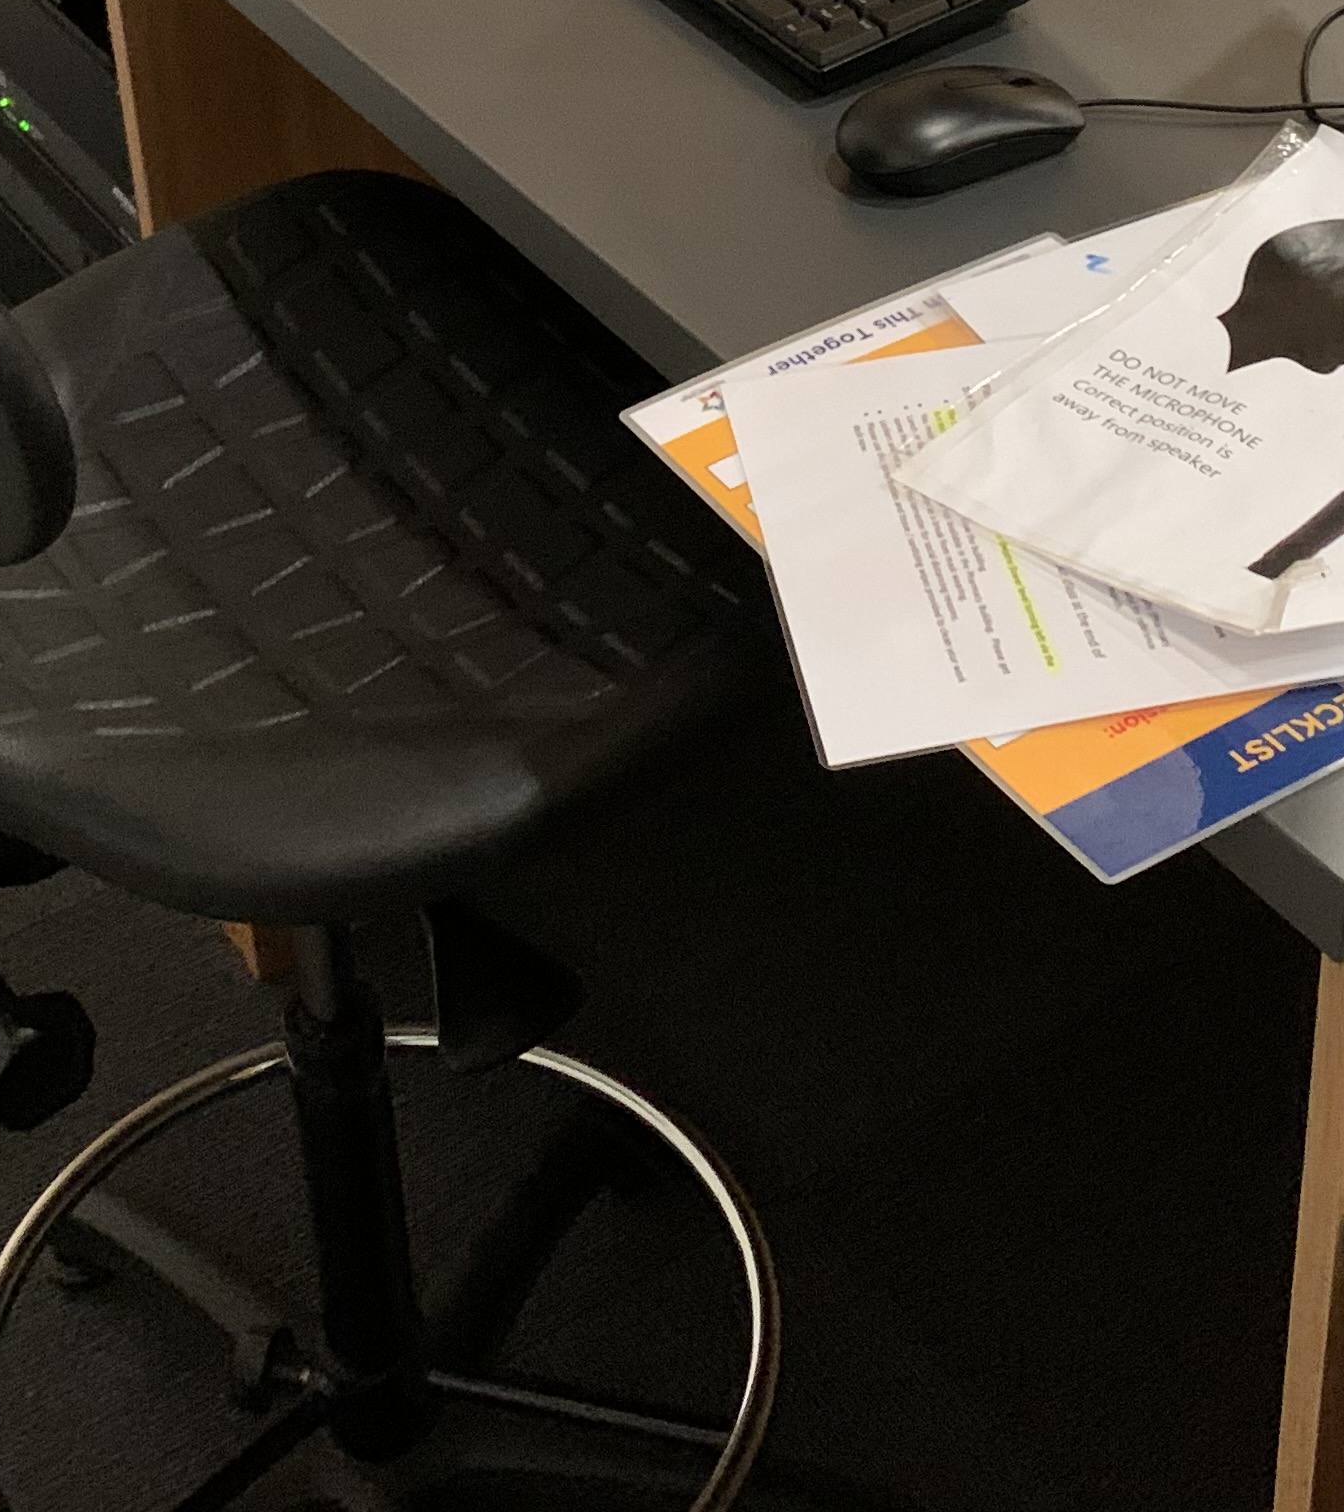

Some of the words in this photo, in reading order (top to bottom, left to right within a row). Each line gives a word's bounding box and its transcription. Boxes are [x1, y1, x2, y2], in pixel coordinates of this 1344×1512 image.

[767, 327, 874, 377] Together
[873, 306, 924, 330] This
[1092, 364, 1130, 388] THE
[1129, 383, 1263, 450] MICROPHONE
[1108, 348, 1142, 370] DO
[1142, 366, 1188, 390] NOT
[1186, 384, 1248, 416] MOVE
[1052, 392, 1101, 422] away
[1100, 417, 1145, 445] from
[1146, 437, 1222, 479] speaker
[1072, 379, 1139, 418] Correct
[1136, 412, 1214, 449] position
[1215, 442, 1235, 460] is
[1076, 609, 1089, 629] the
[1083, 627, 1098, 650] end
[1091, 646, 1103, 661] of
